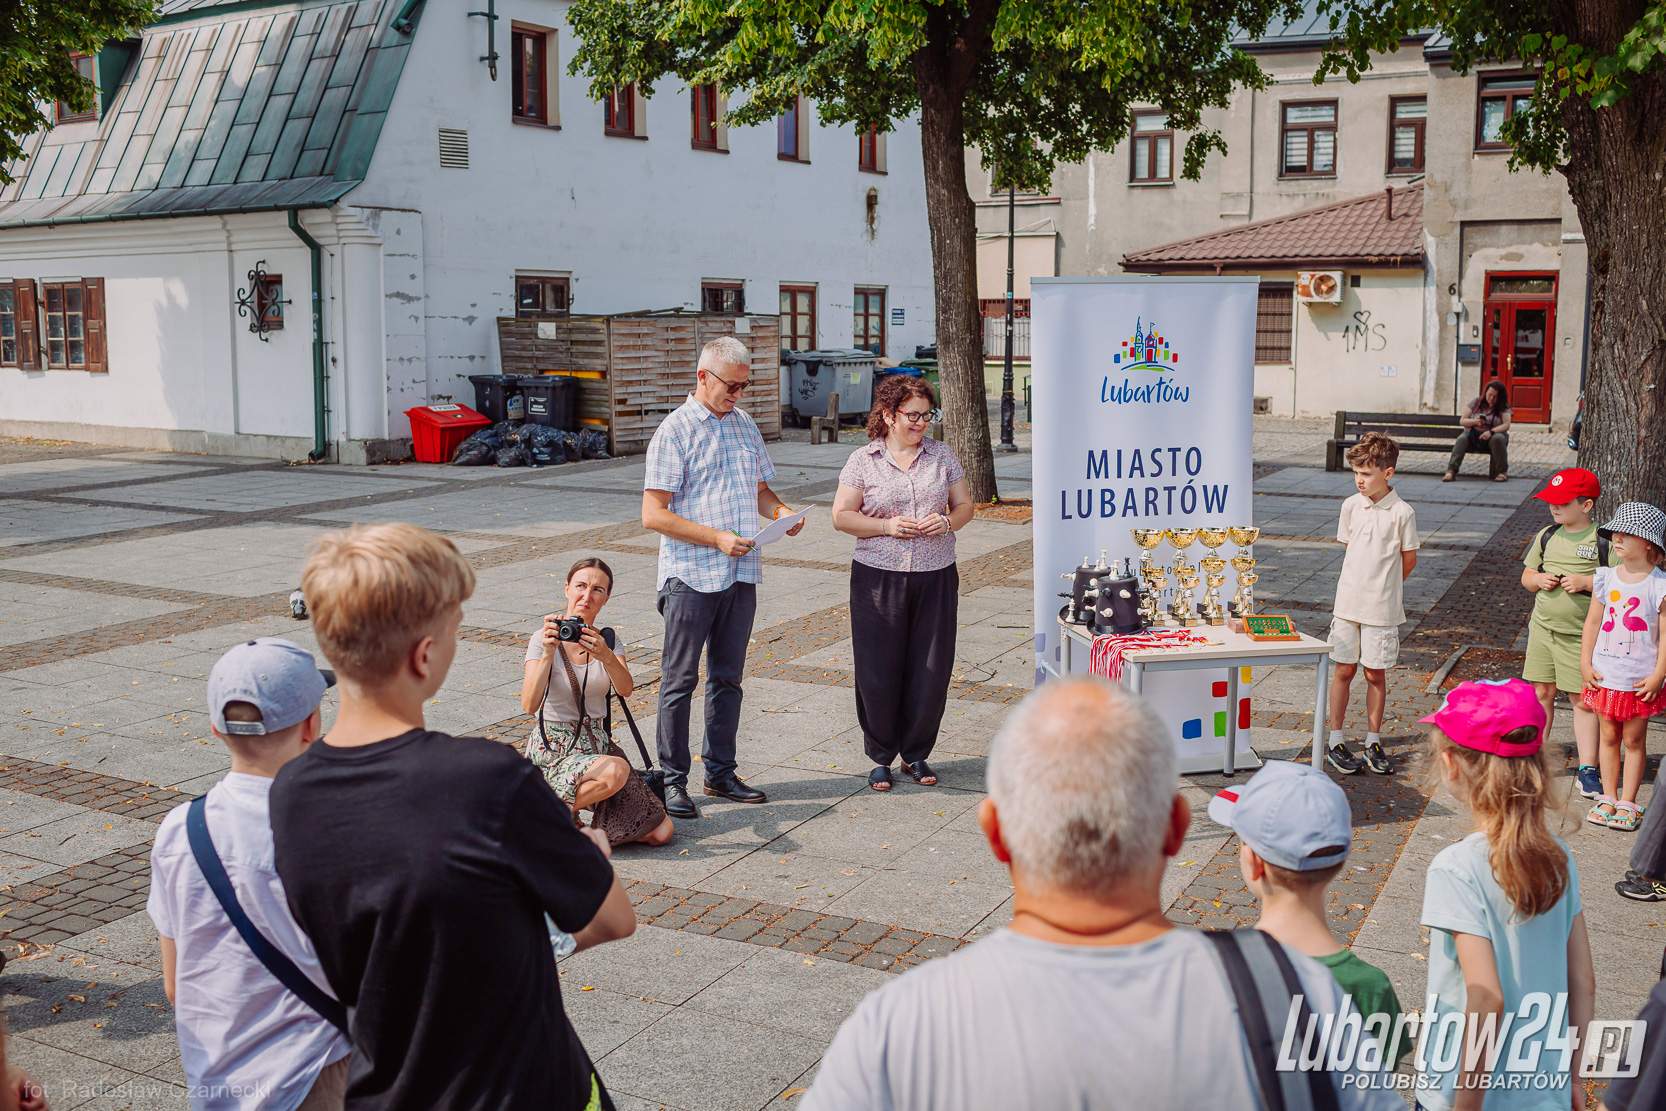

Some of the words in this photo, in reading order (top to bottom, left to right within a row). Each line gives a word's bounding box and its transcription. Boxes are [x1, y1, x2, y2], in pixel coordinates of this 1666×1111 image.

[1447, 282, 1457, 296] 6
[1101, 376, 1190, 404] Lubartów
[1086, 446, 1202, 480] MIASTO
[1061, 479, 1229, 520] LUBARTÓW
